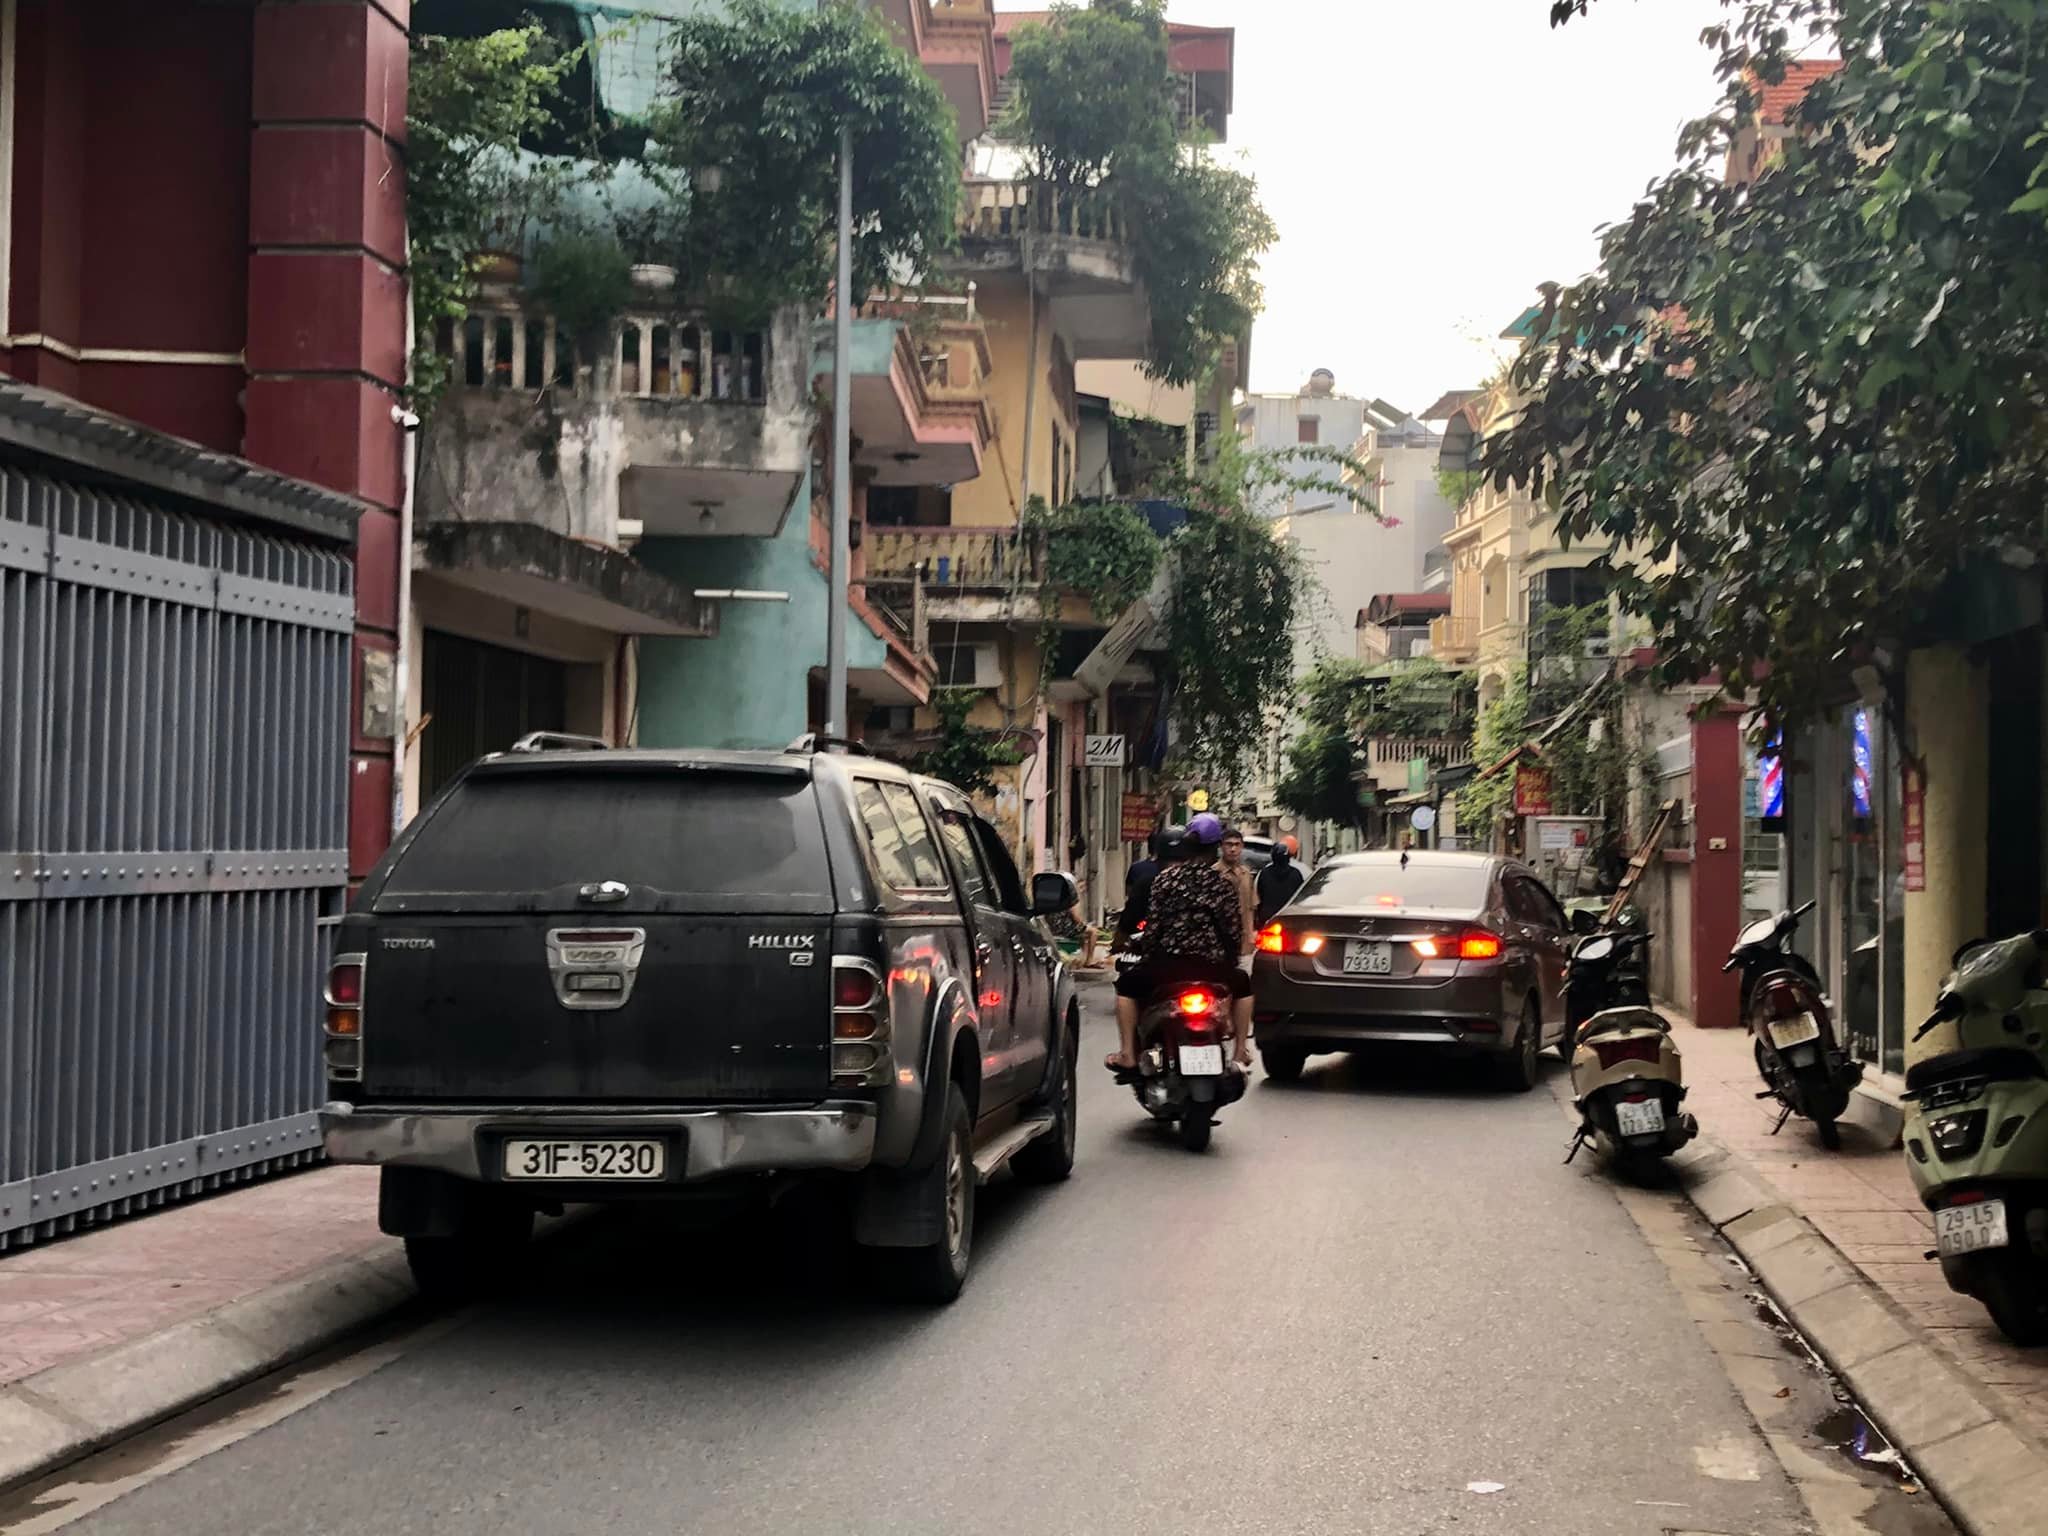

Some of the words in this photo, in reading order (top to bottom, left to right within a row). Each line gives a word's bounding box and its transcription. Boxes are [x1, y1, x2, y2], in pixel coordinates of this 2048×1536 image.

[1087, 737, 1122, 756] 2M
[382, 938, 435, 949] TOYOTA
[748, 934, 815, 949] HILUX
[1945, 1204, 1994, 1231] 29-L5
